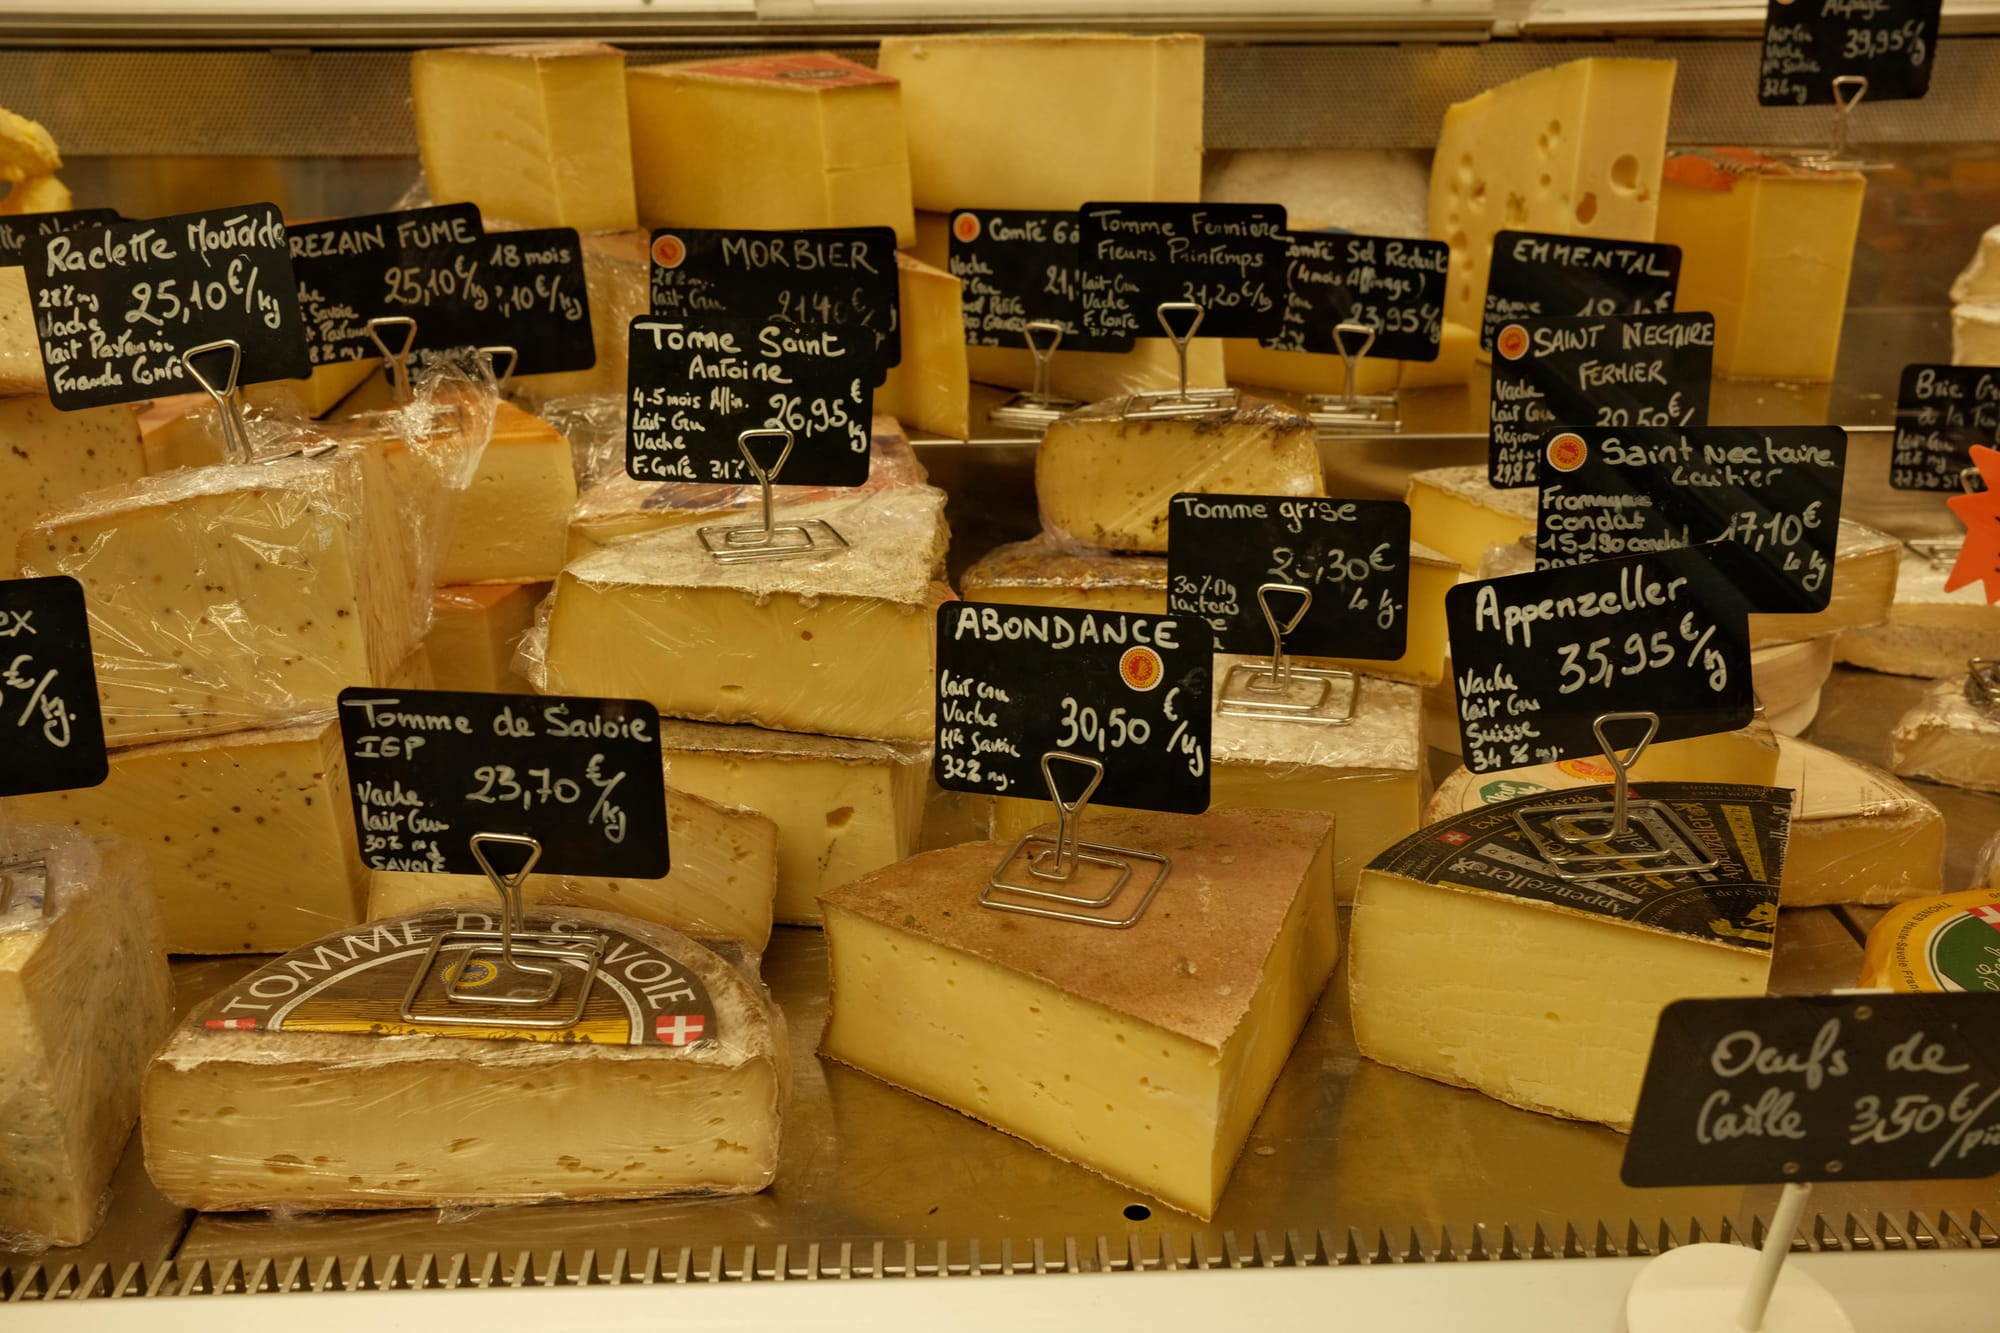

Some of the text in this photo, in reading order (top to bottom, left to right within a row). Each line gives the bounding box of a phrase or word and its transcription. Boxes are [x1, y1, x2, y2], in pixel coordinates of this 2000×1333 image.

[290, 217, 477, 259] REZAIN FUME
[988, 217, 1047, 243] Comté
[1089, 209, 1177, 237] Tomme
[46, 228, 177, 278] Raclette
[490, 244, 572, 268] 18 mois
[721, 236, 879, 275] MORBIER
[1097, 236, 1264, 279] Fleurs Printemps
[1512, 238, 1671, 278] EMMENTAL
[1043, 264, 1080, 303] 21,
[1081, 288, 1131, 311] Vache
[45, 338, 83, 365] lait
[758, 325, 846, 358] Saint
[1533, 322, 1714, 358] SAINT NECTAIRE
[688, 353, 793, 384] Antoine
[1578, 359, 1668, 391] FERMIER
[1914, 367, 1964, 400] Brie
[667, 391, 702, 409] mois
[763, 392, 849, 438] 26,95
[632, 431, 687, 452] Vache
[1600, 434, 1836, 467] Saint Nectaire
[1671, 464, 1784, 488] Laitier
[1172, 497, 1358, 534] Tomme grise
[1474, 563, 1689, 649] Appenzeller
[954, 605, 1180, 651] ABONDANCE
[1557, 630, 1676, 695] 35,95
[941, 668, 975, 699] lait
[1458, 662, 1519, 698] Vache
[341, 697, 653, 743] Tomme de Savoie
[942, 698, 999, 728] Vache
[1055, 696, 1151, 753] 30,50
[1461, 696, 1501, 721] lait
[353, 734, 427, 761] IGP
[1465, 721, 1541, 750] Suisse
[356, 779, 425, 808] Vache
[465, 764, 581, 812] 23,70
[360, 803, 405, 833] lait
[369, 854, 451, 873] SAVOIE
[1486, 864, 1632, 915] Appenzeller
[219, 918, 434, 1014] TOMME
[1710, 1017, 1971, 1090] Oeufs de
[1696, 1086, 1807, 1145] Caille
